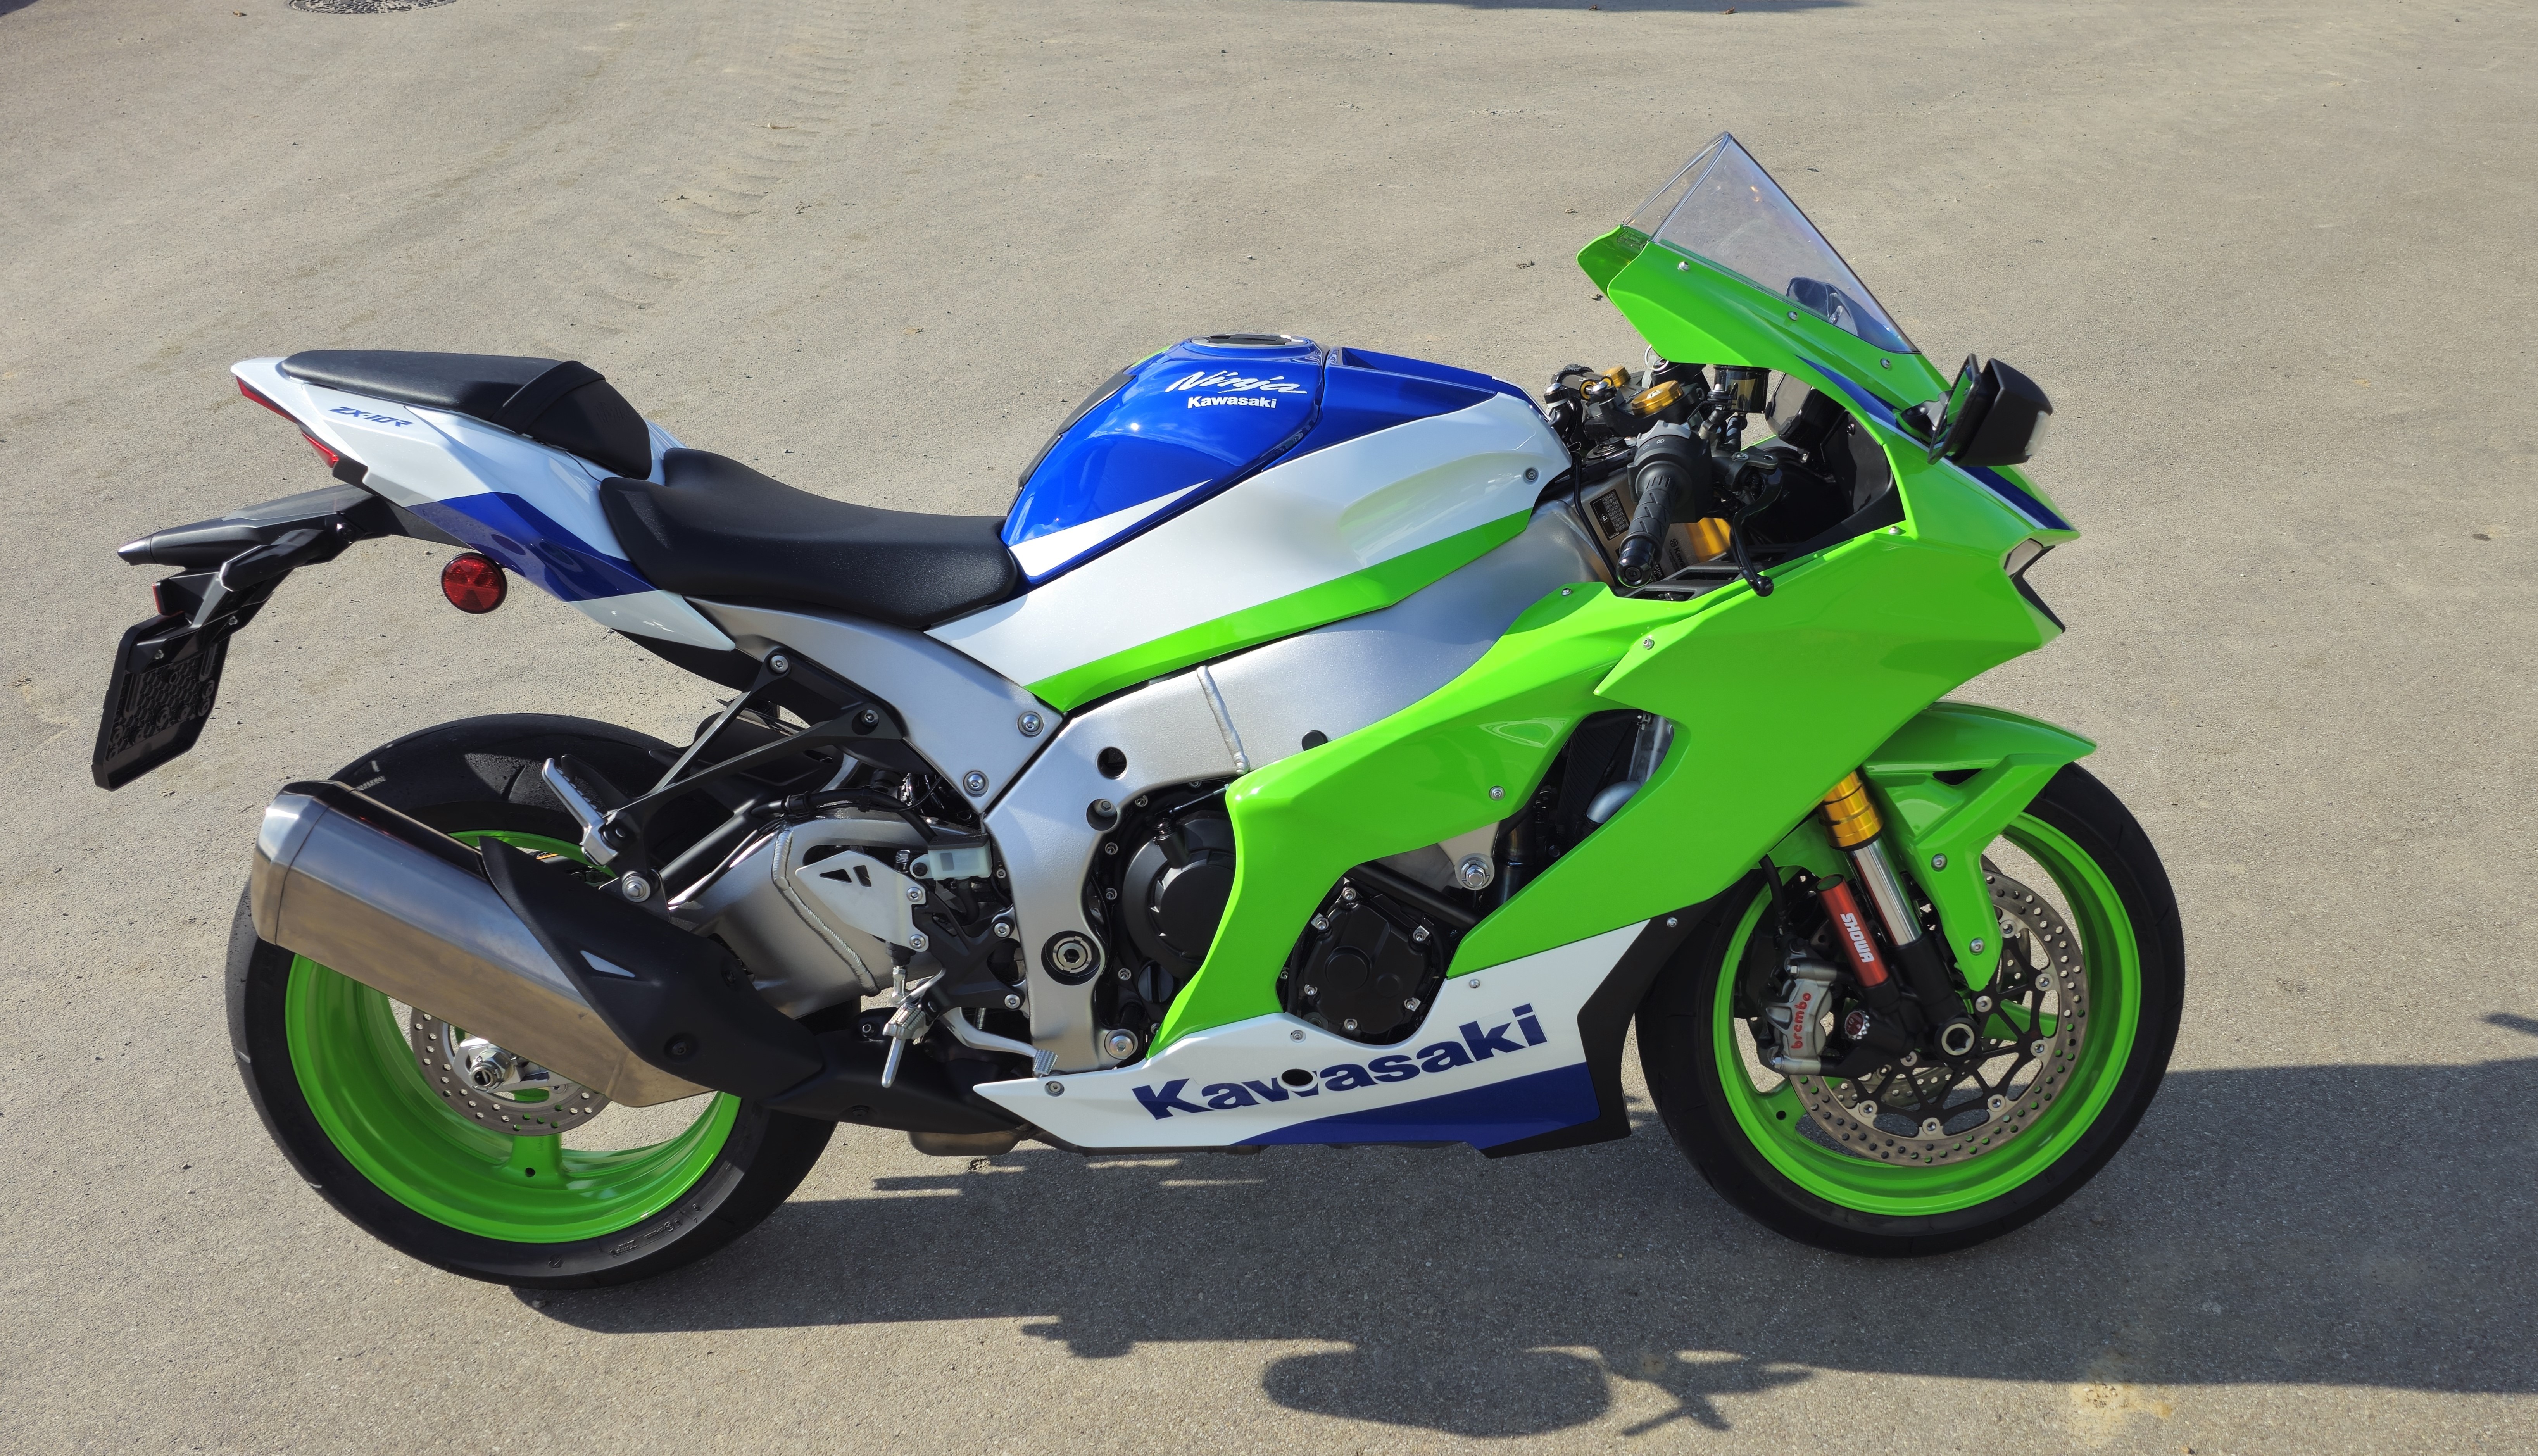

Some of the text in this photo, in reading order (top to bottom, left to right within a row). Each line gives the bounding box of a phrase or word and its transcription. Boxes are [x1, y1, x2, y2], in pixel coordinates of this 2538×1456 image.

[1165, 371, 1307, 394] Ninja
[328, 406, 413, 427] ZX-10R
[1187, 396, 1277, 409] Kawasaki
[1840, 913, 1874, 963] SHOWA
[1790, 992, 1812, 1050] brembo
[1132, 1002, 1548, 1120] Kawasaki
